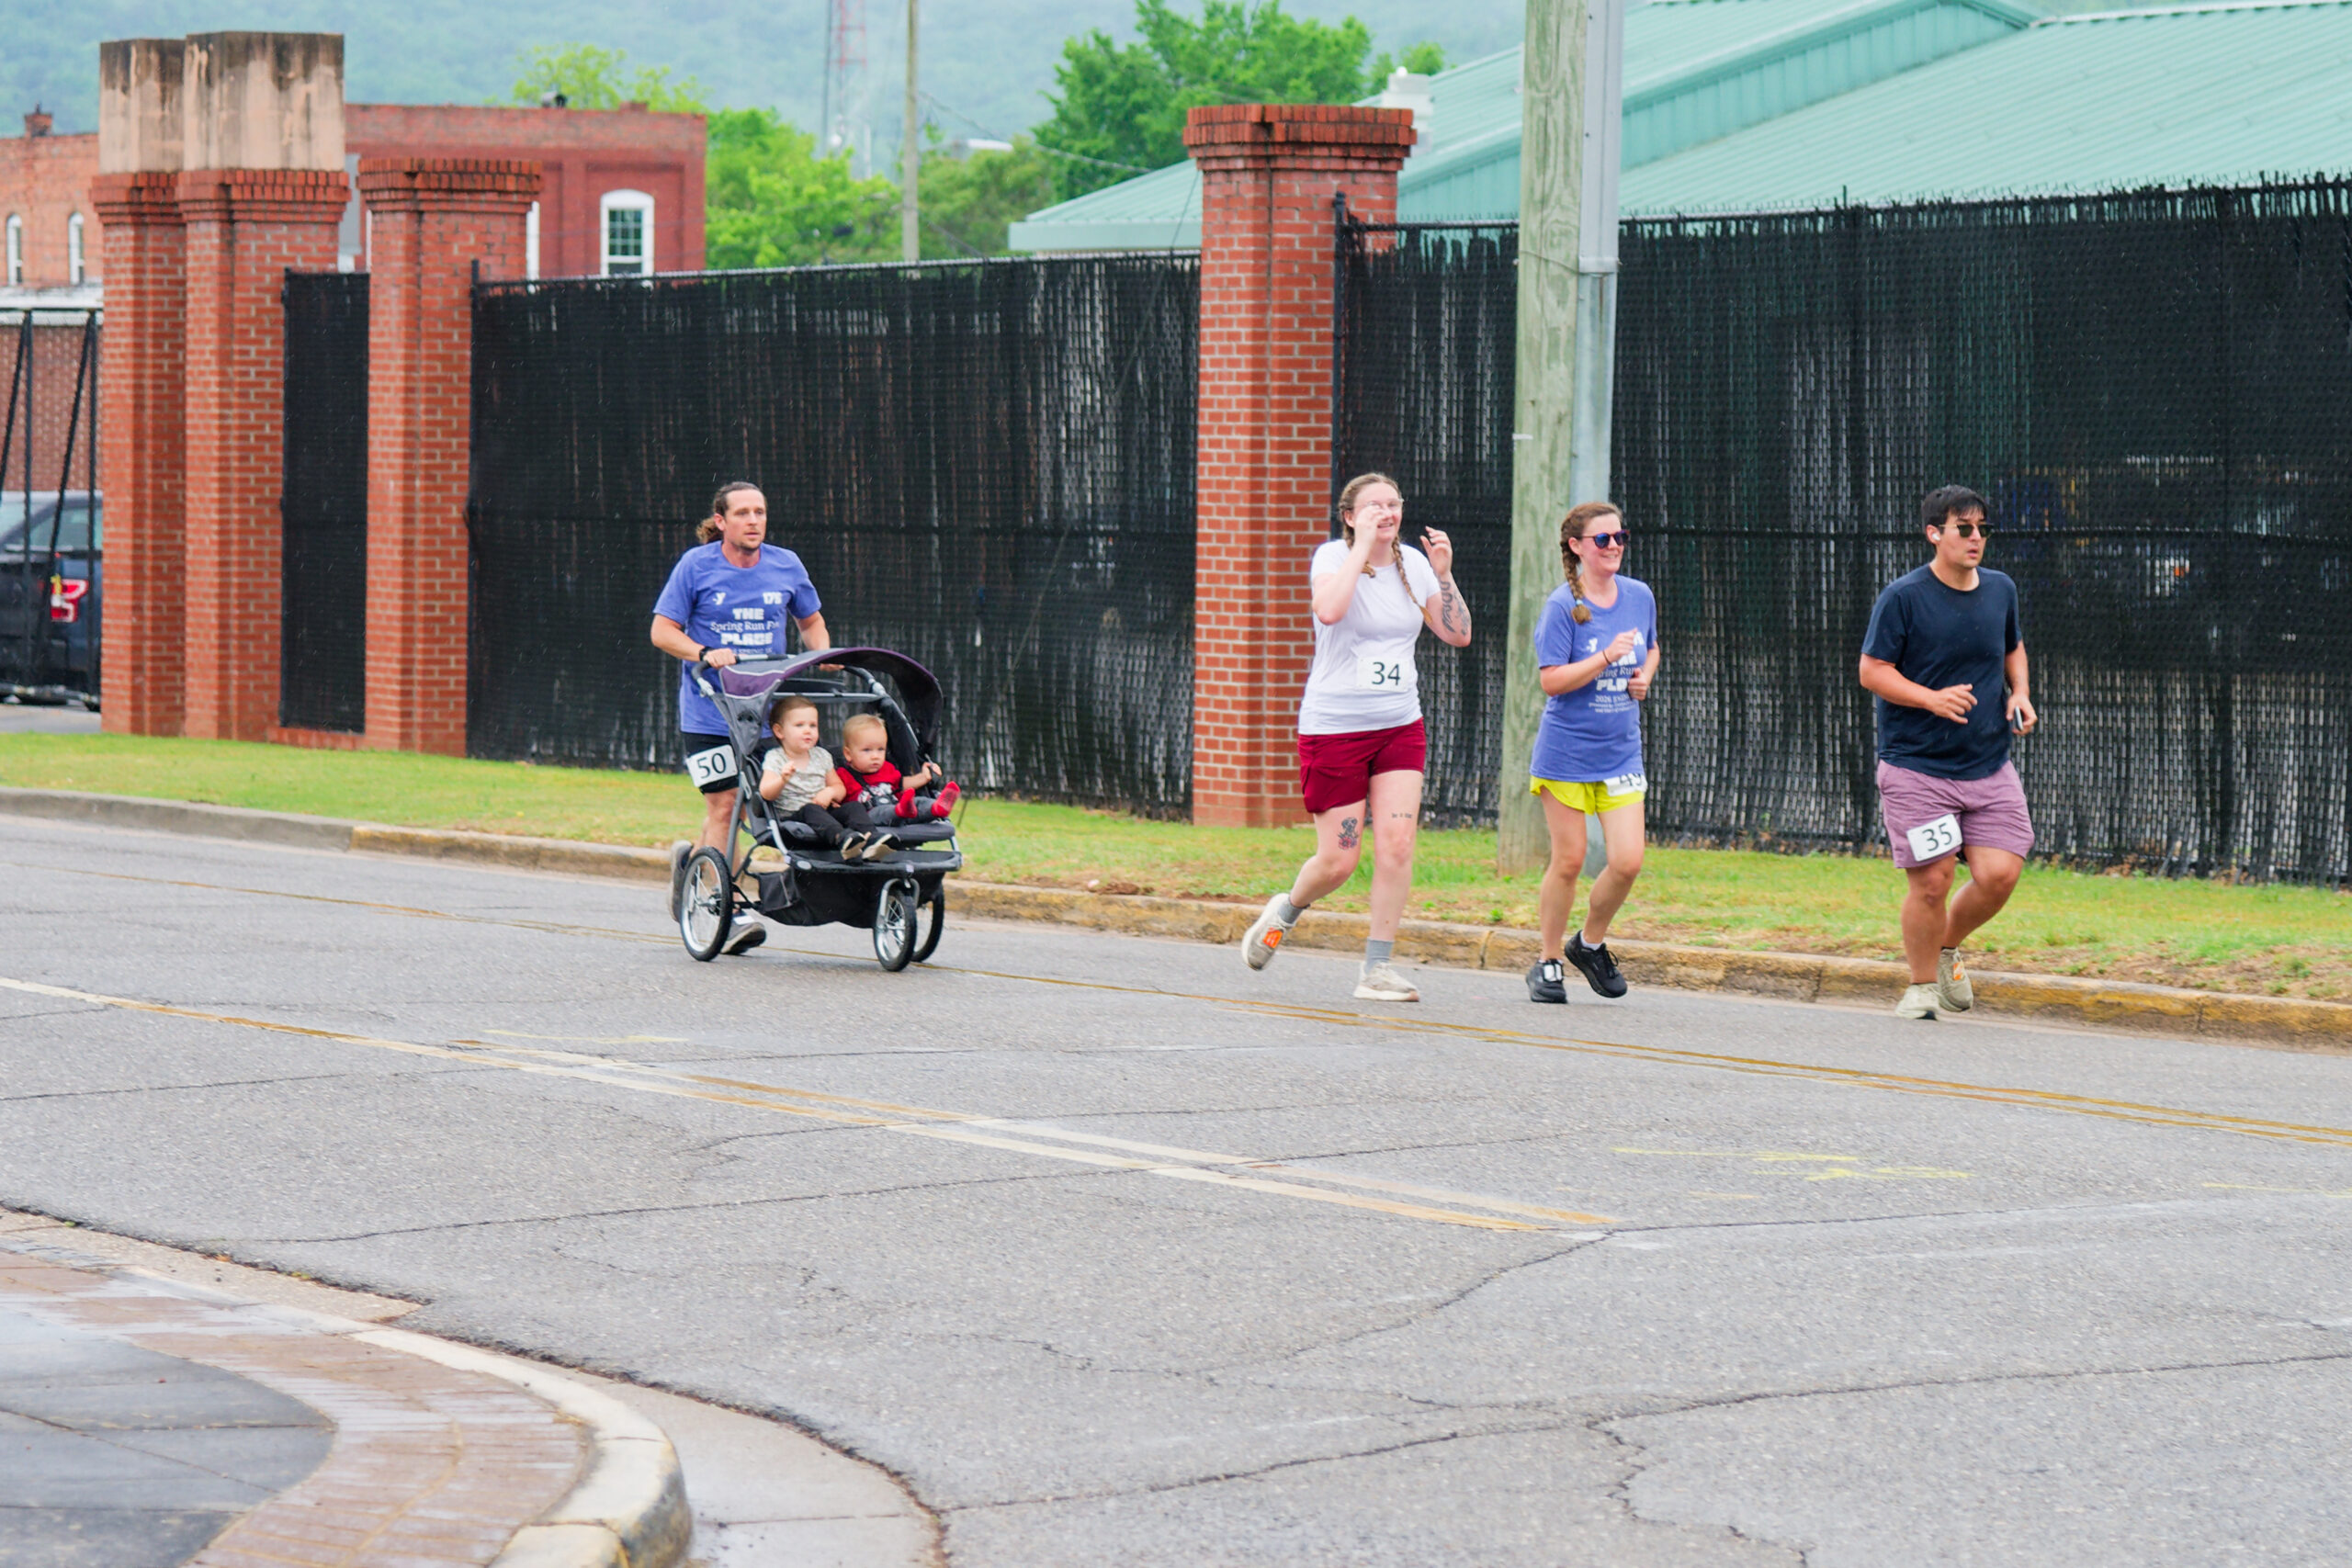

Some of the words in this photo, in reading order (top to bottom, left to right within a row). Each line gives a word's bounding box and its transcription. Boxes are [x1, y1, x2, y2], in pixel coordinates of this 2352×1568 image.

[732, 607, 764, 620] THE
[710, 621, 743, 633] Spring
[744, 620, 764, 631] Run
[721, 632, 773, 645] PLACE
[1372, 661, 1401, 686] 34
[696, 752, 726, 779] 50
[1922, 822, 1952, 852] 35
